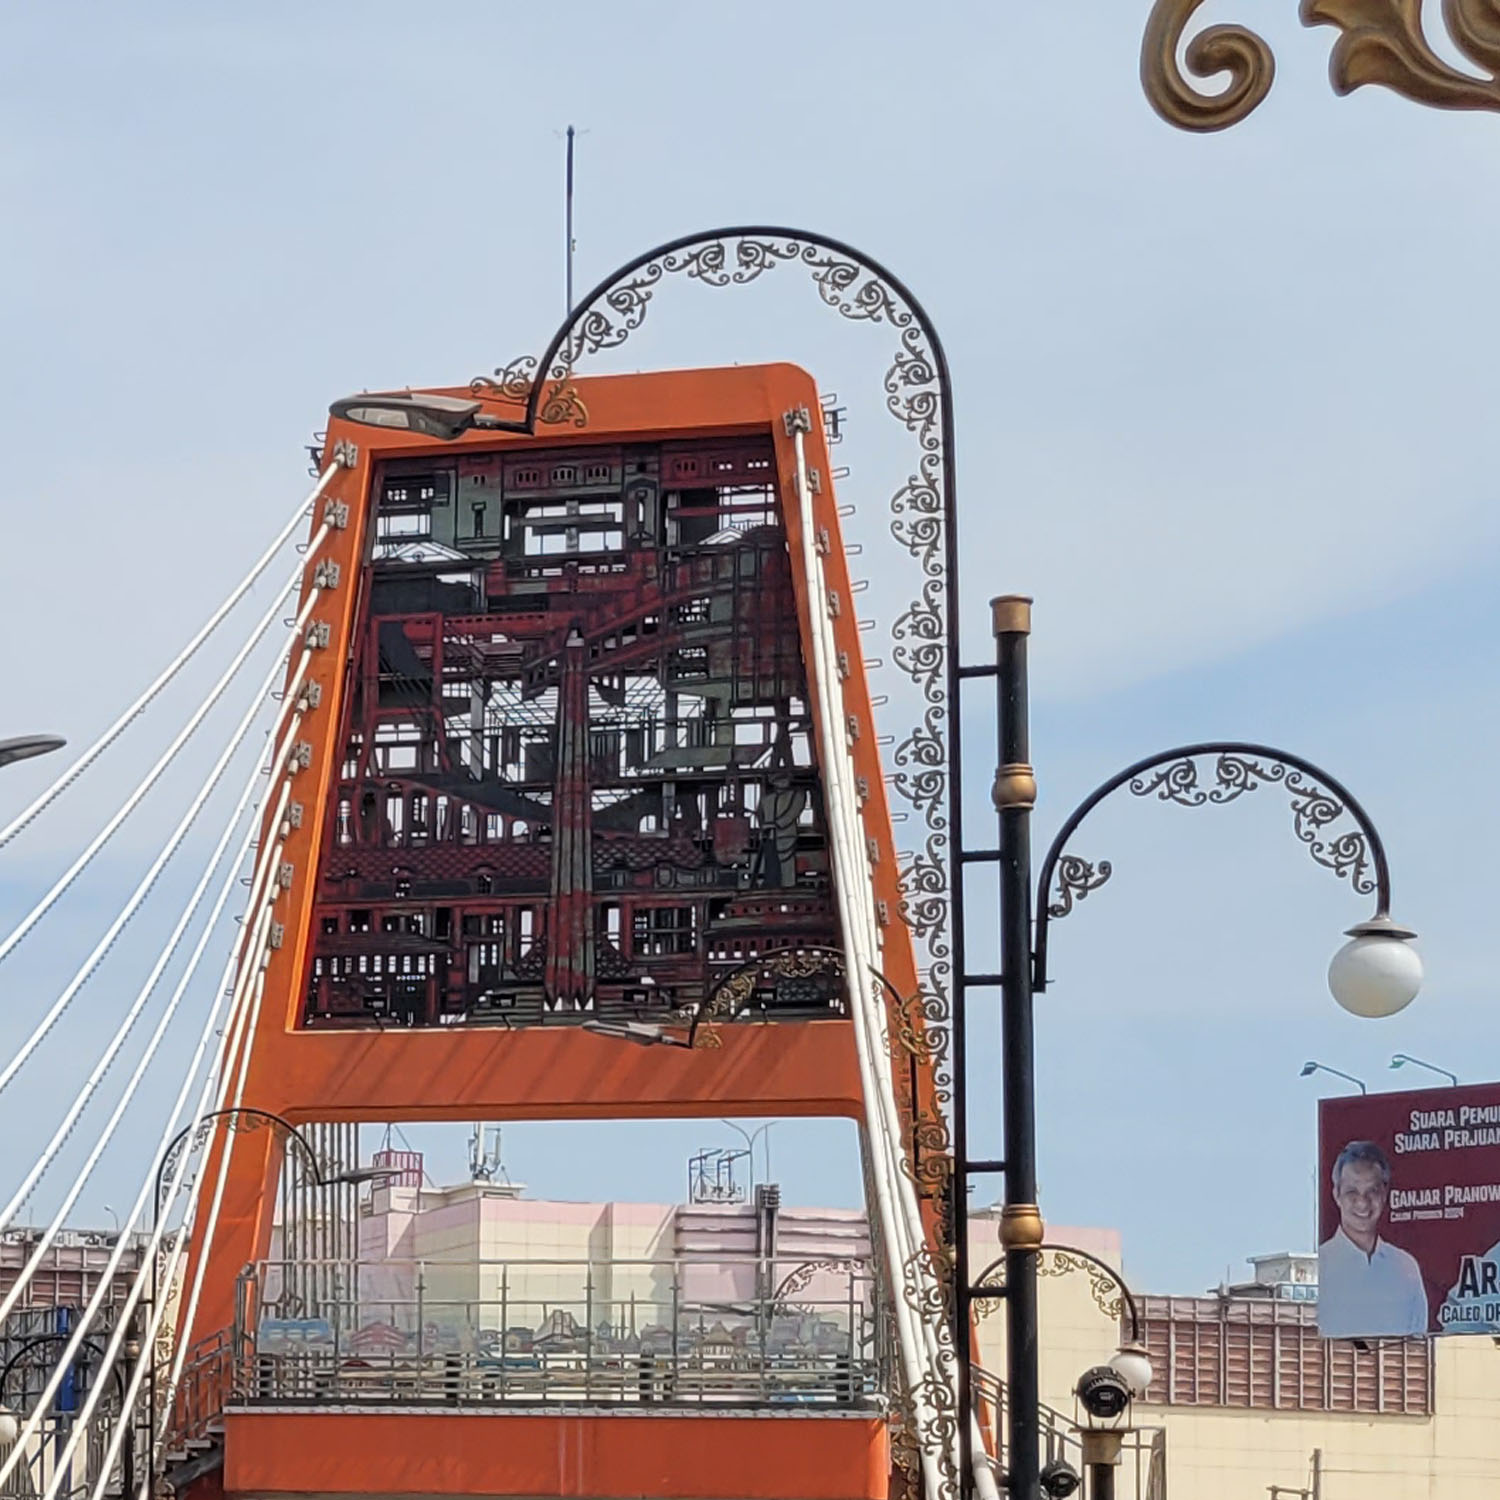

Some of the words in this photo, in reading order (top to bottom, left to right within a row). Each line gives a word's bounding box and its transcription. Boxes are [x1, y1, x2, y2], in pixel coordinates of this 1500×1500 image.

[1410, 1110, 1456, 1131] SUARA
[1460, 1105, 1500, 1127] PEMU
[1394, 1132, 1440, 1153] SUARA
[1390, 1188, 1440, 1209] GANJAR
[1457, 1257, 1500, 1298] AR
